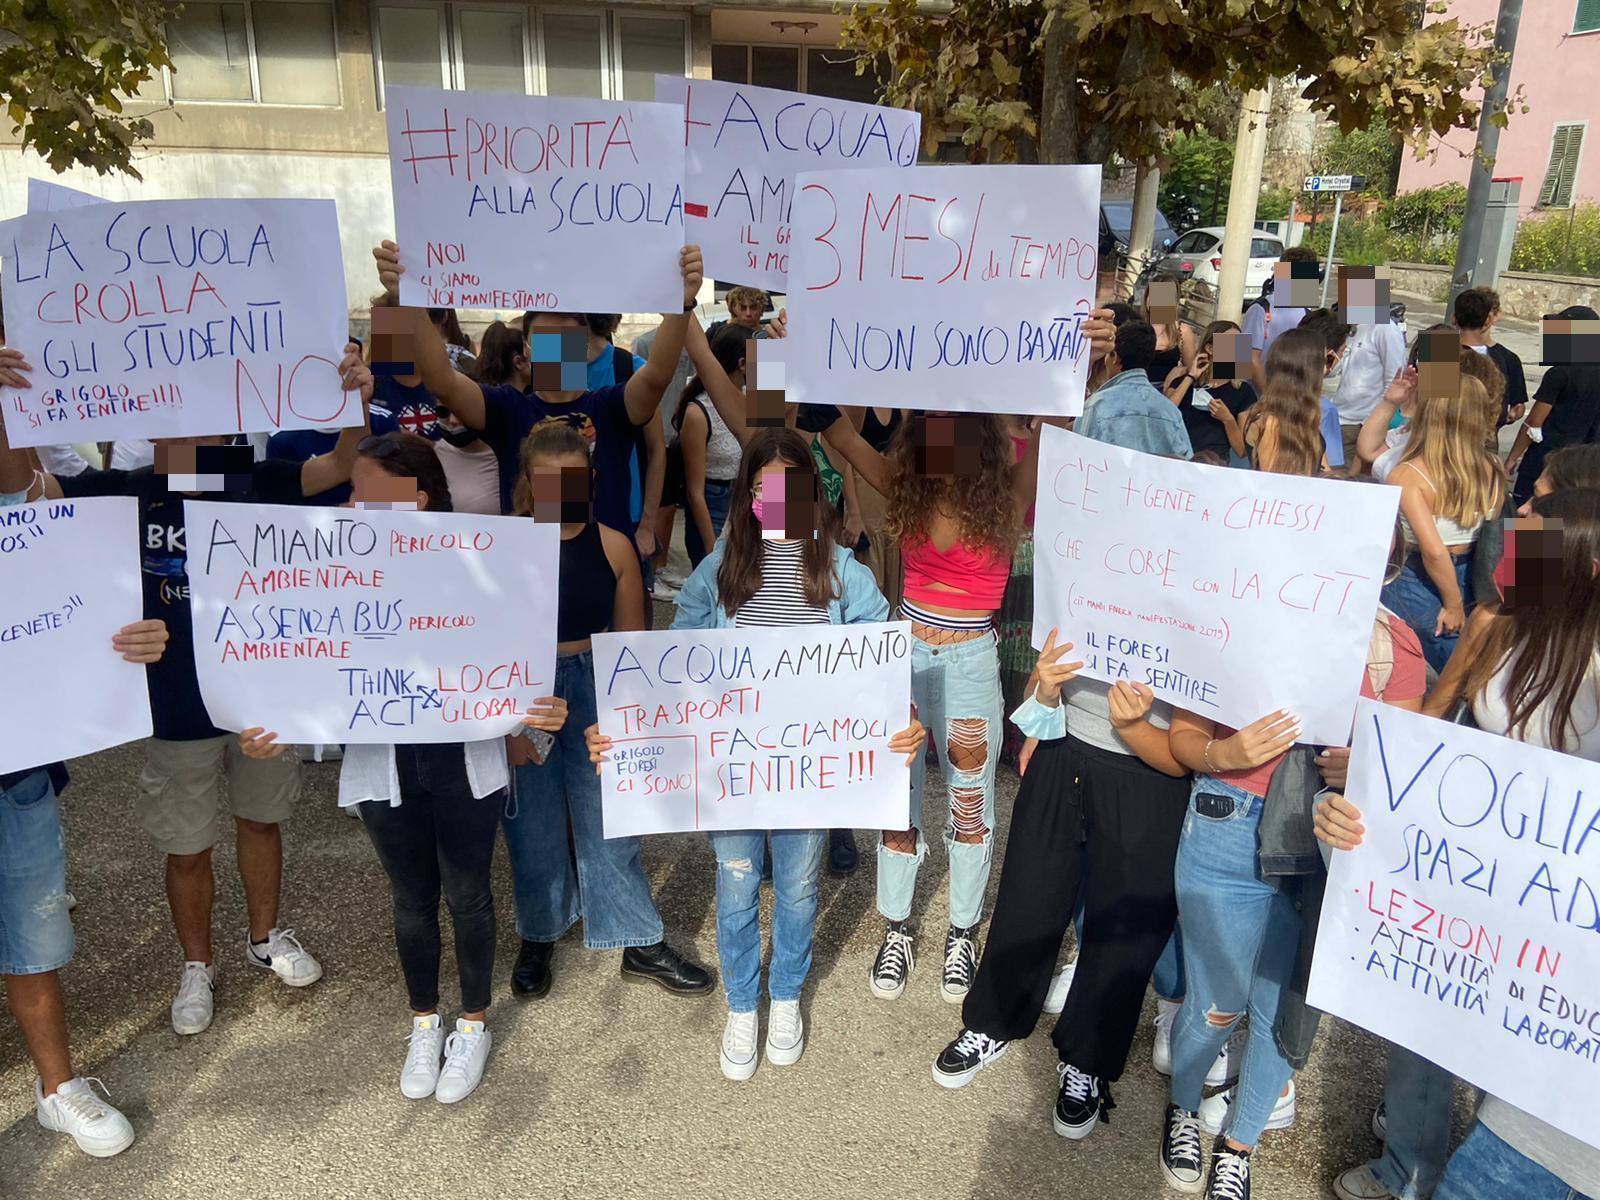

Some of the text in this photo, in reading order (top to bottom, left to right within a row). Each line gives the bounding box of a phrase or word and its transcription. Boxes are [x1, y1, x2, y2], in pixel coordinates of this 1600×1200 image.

[468, 177, 684, 232] ALLA SCUOLA
[13, 211, 275, 282] LA SCUOLA
[741, 225, 759, 244] IL
[802, 184, 1097, 290] 3 MESI di TEMPO
[427, 241, 465, 268] NOI
[747, 251, 757, 269] SI
[37, 271, 227, 324] CROLLA
[420, 272, 480, 289] CI SIAMO
[427, 288, 559, 309] NOI MANIFESTIAMO
[44, 301, 284, 378] GLI STUDENTI
[828, 318, 915, 371] NON
[928, 321, 1009, 369] SONO
[14, 384, 129, 413] IL GRIGOLO
[237, 355, 347, 431] NO
[28, 413, 42, 428] SI
[47, 408, 68, 421] FA
[49, 504, 74, 519] UN
[1223, 496, 1325, 532] CHIESSI
[206, 519, 493, 575] AMIANTO PERICOLO
[235, 565, 385, 600] AMBIENTALE
[1053, 531, 1083, 560] CHE
[1104, 543, 1181, 587] CORSE
[1232, 567, 1261, 600] LA
[1278, 571, 1370, 615] CTT
[214, 599, 475, 643] ASSENZA BUS PERICOLO
[221, 637, 352, 663] AMBIENTALE
[775, 629, 907, 678] AMIANTO
[1086, 631, 1169, 663] IL FORESI
[338, 661, 543, 696] THINK LOCAL
[1085, 653, 1220, 708] SI FA SENTIRE
[349, 695, 524, 729] ACT GLOBAL
[614, 688, 760, 735] TRASPORTI
[614, 746, 664, 761] GRIGOLO
[710, 718, 887, 757] FACCIAMOCI
[616, 774, 692, 795] CI SONO
[1389, 823, 1498, 897] SPAZI
[1508, 980, 1524, 1001] DI
